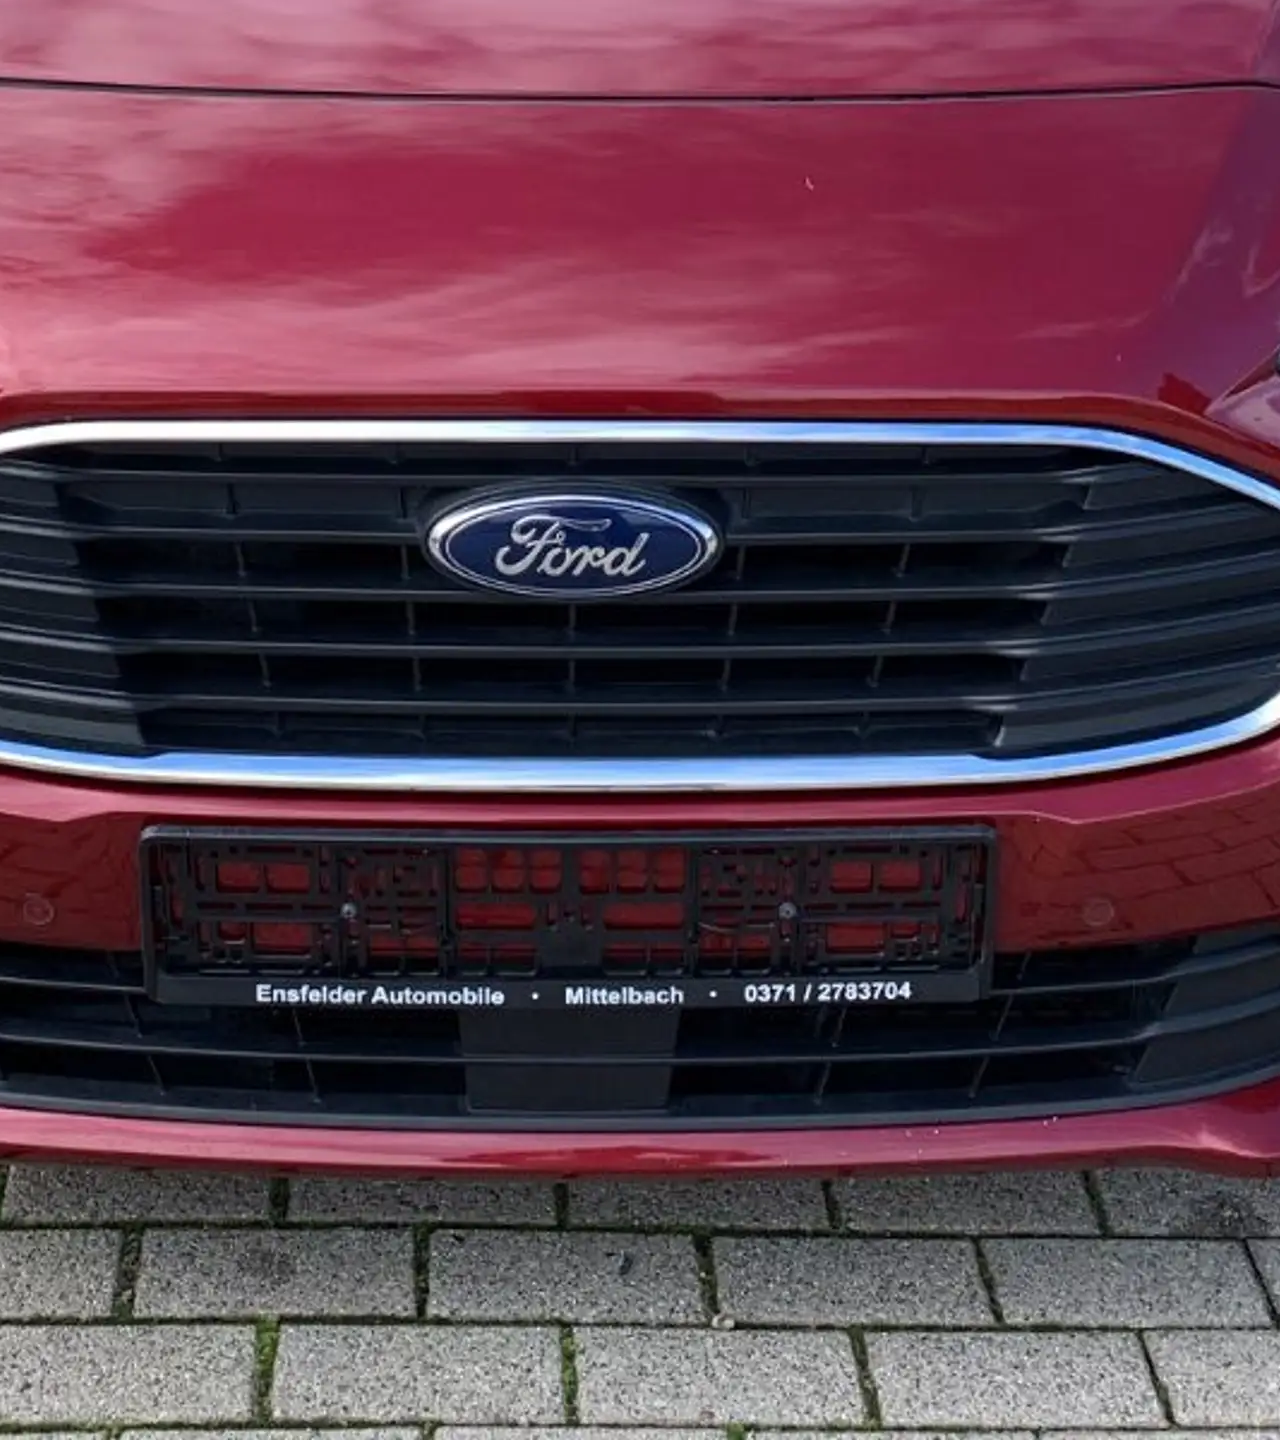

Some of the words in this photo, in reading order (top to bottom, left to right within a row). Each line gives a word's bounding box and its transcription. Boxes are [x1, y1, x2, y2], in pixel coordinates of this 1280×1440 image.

[493, 512, 651, 578] Ford
[255, 984, 367, 1004] Ensfelder
[371, 986, 506, 1006] Automobile
[564, 986, 685, 1006] Mittelbach
[743, 983, 797, 1003] 0371
[818, 981, 912, 1002] 2783704
